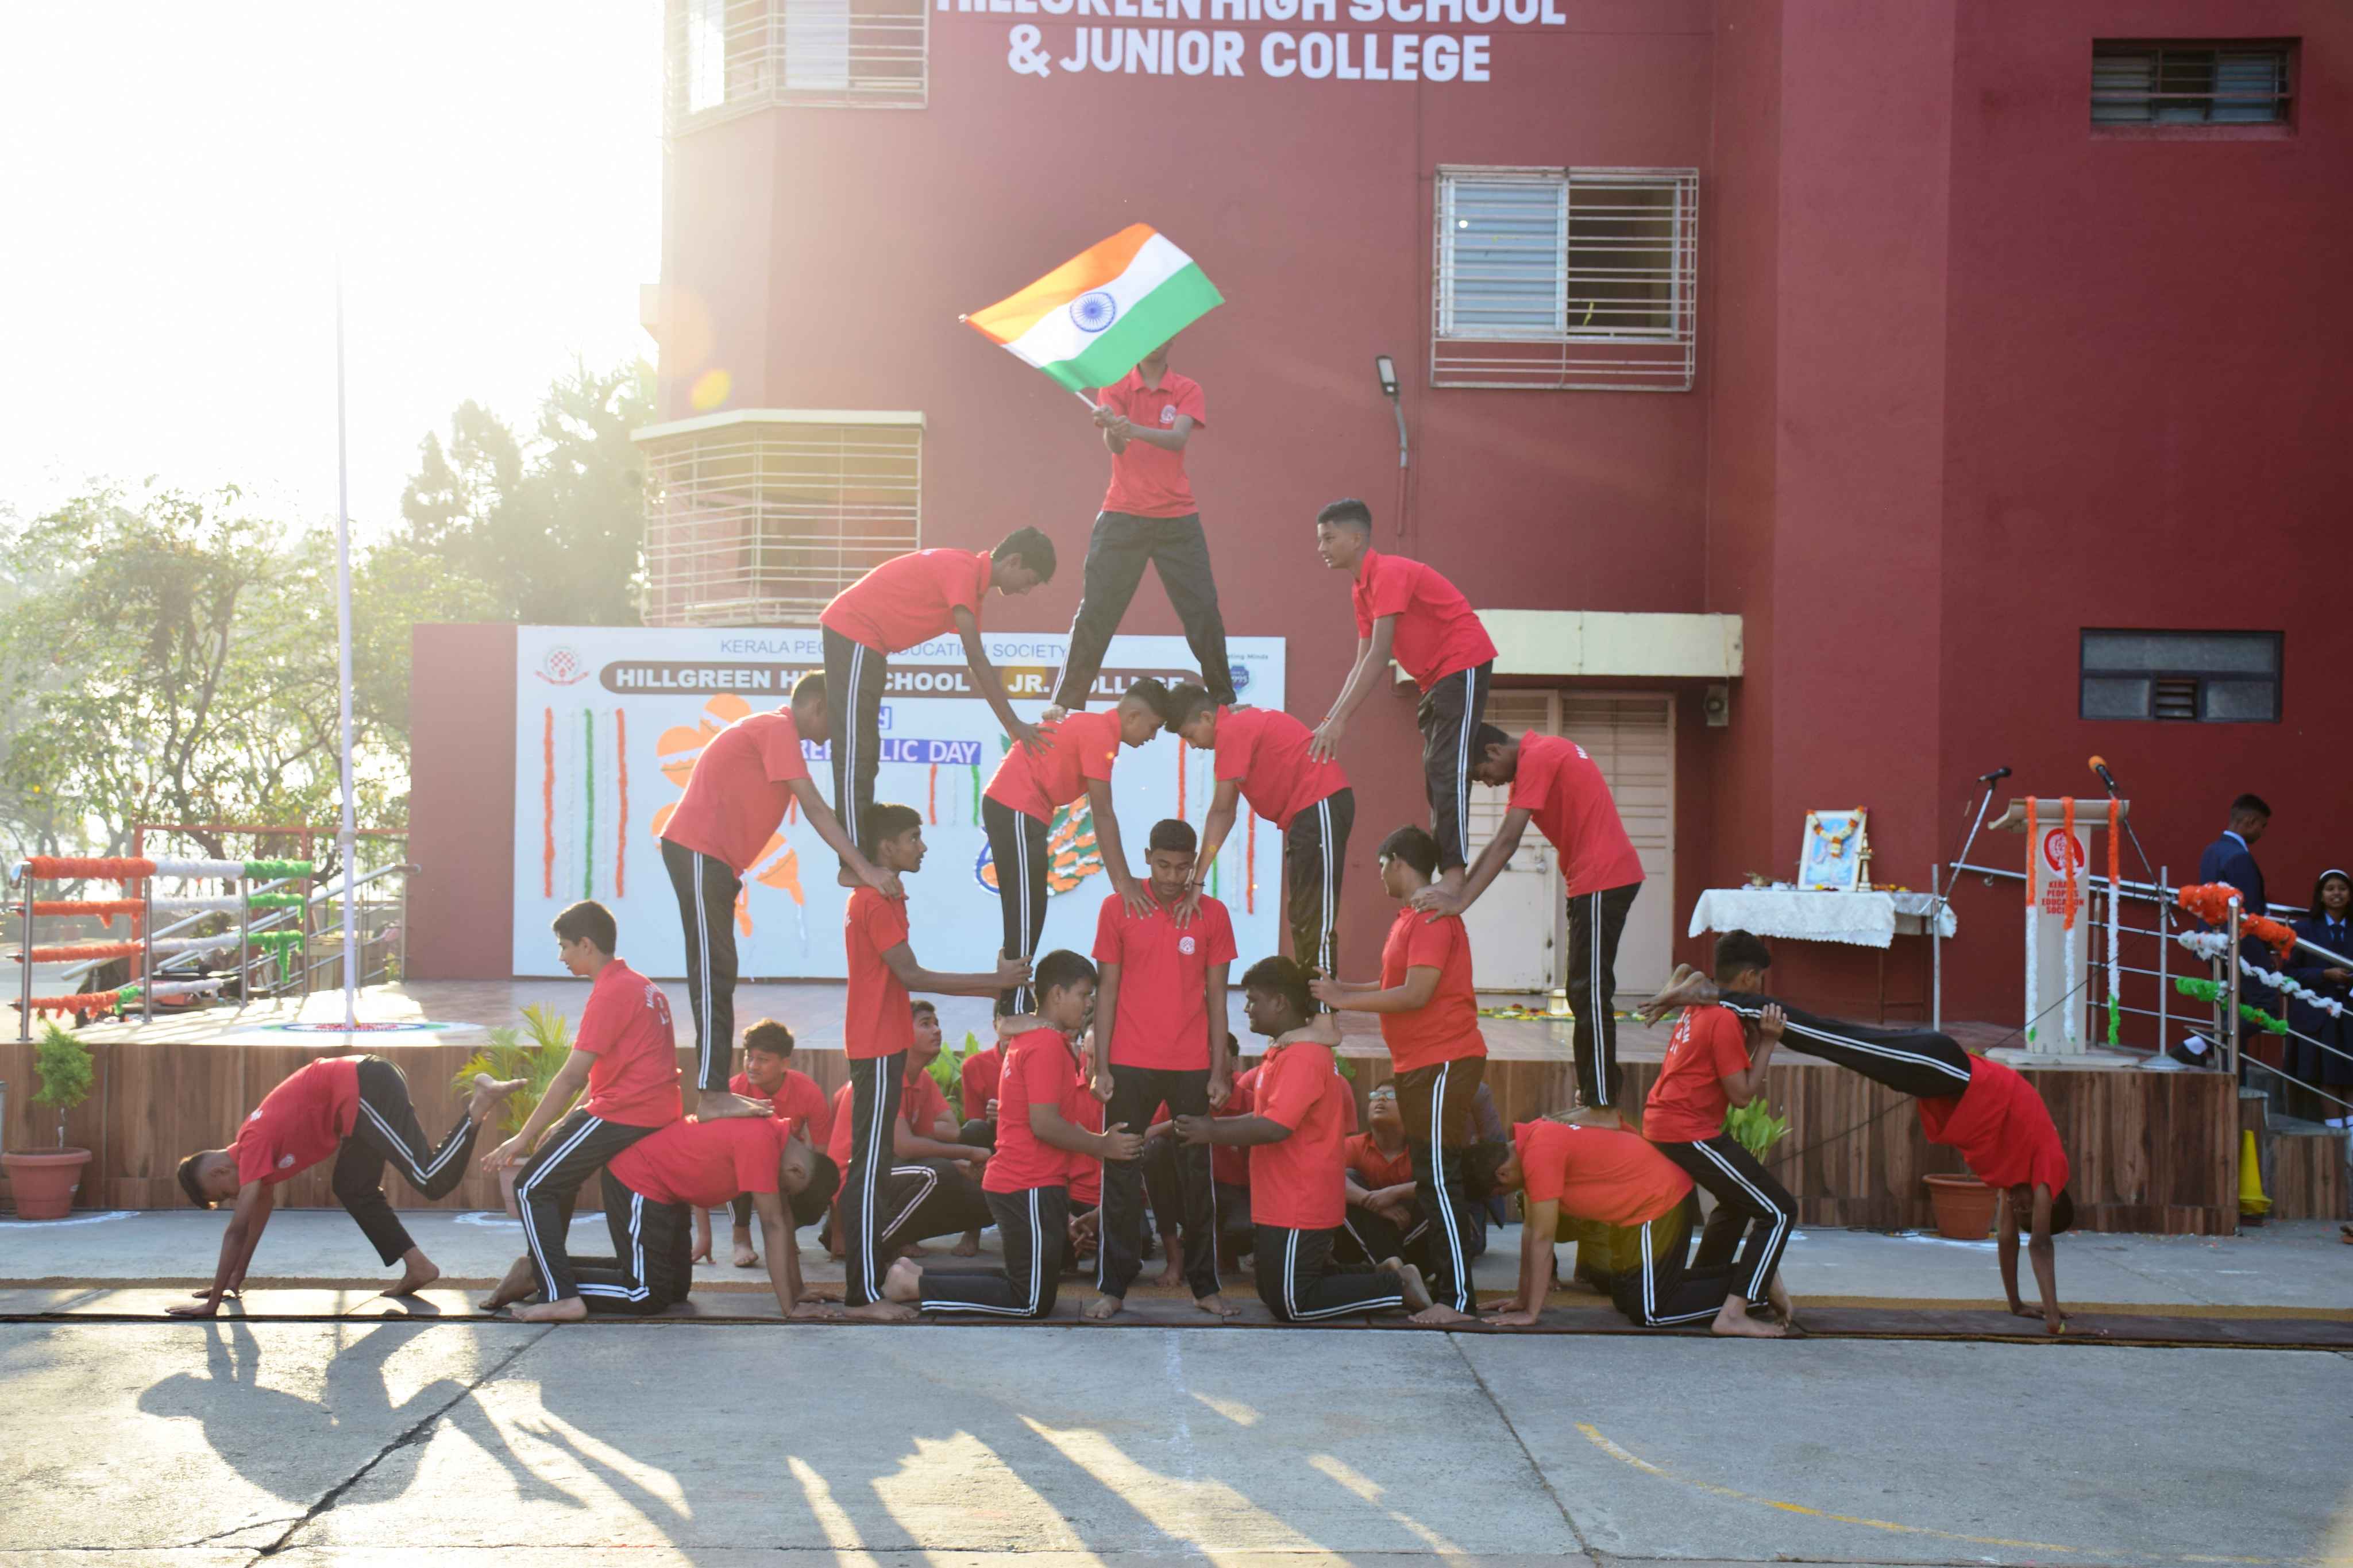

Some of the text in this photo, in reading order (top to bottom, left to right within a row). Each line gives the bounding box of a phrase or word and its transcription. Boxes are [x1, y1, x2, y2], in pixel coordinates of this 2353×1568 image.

[1008, 24, 1491, 82] & JUNIOR COLLEGE
[720, 639, 790, 654] KERALA
[992, 643, 1066, 658] SOCIETY
[616, 669, 771, 689] HILLGREEN
[1007, 674, 1051, 693] JR.
[928, 741, 978, 763] DAY
